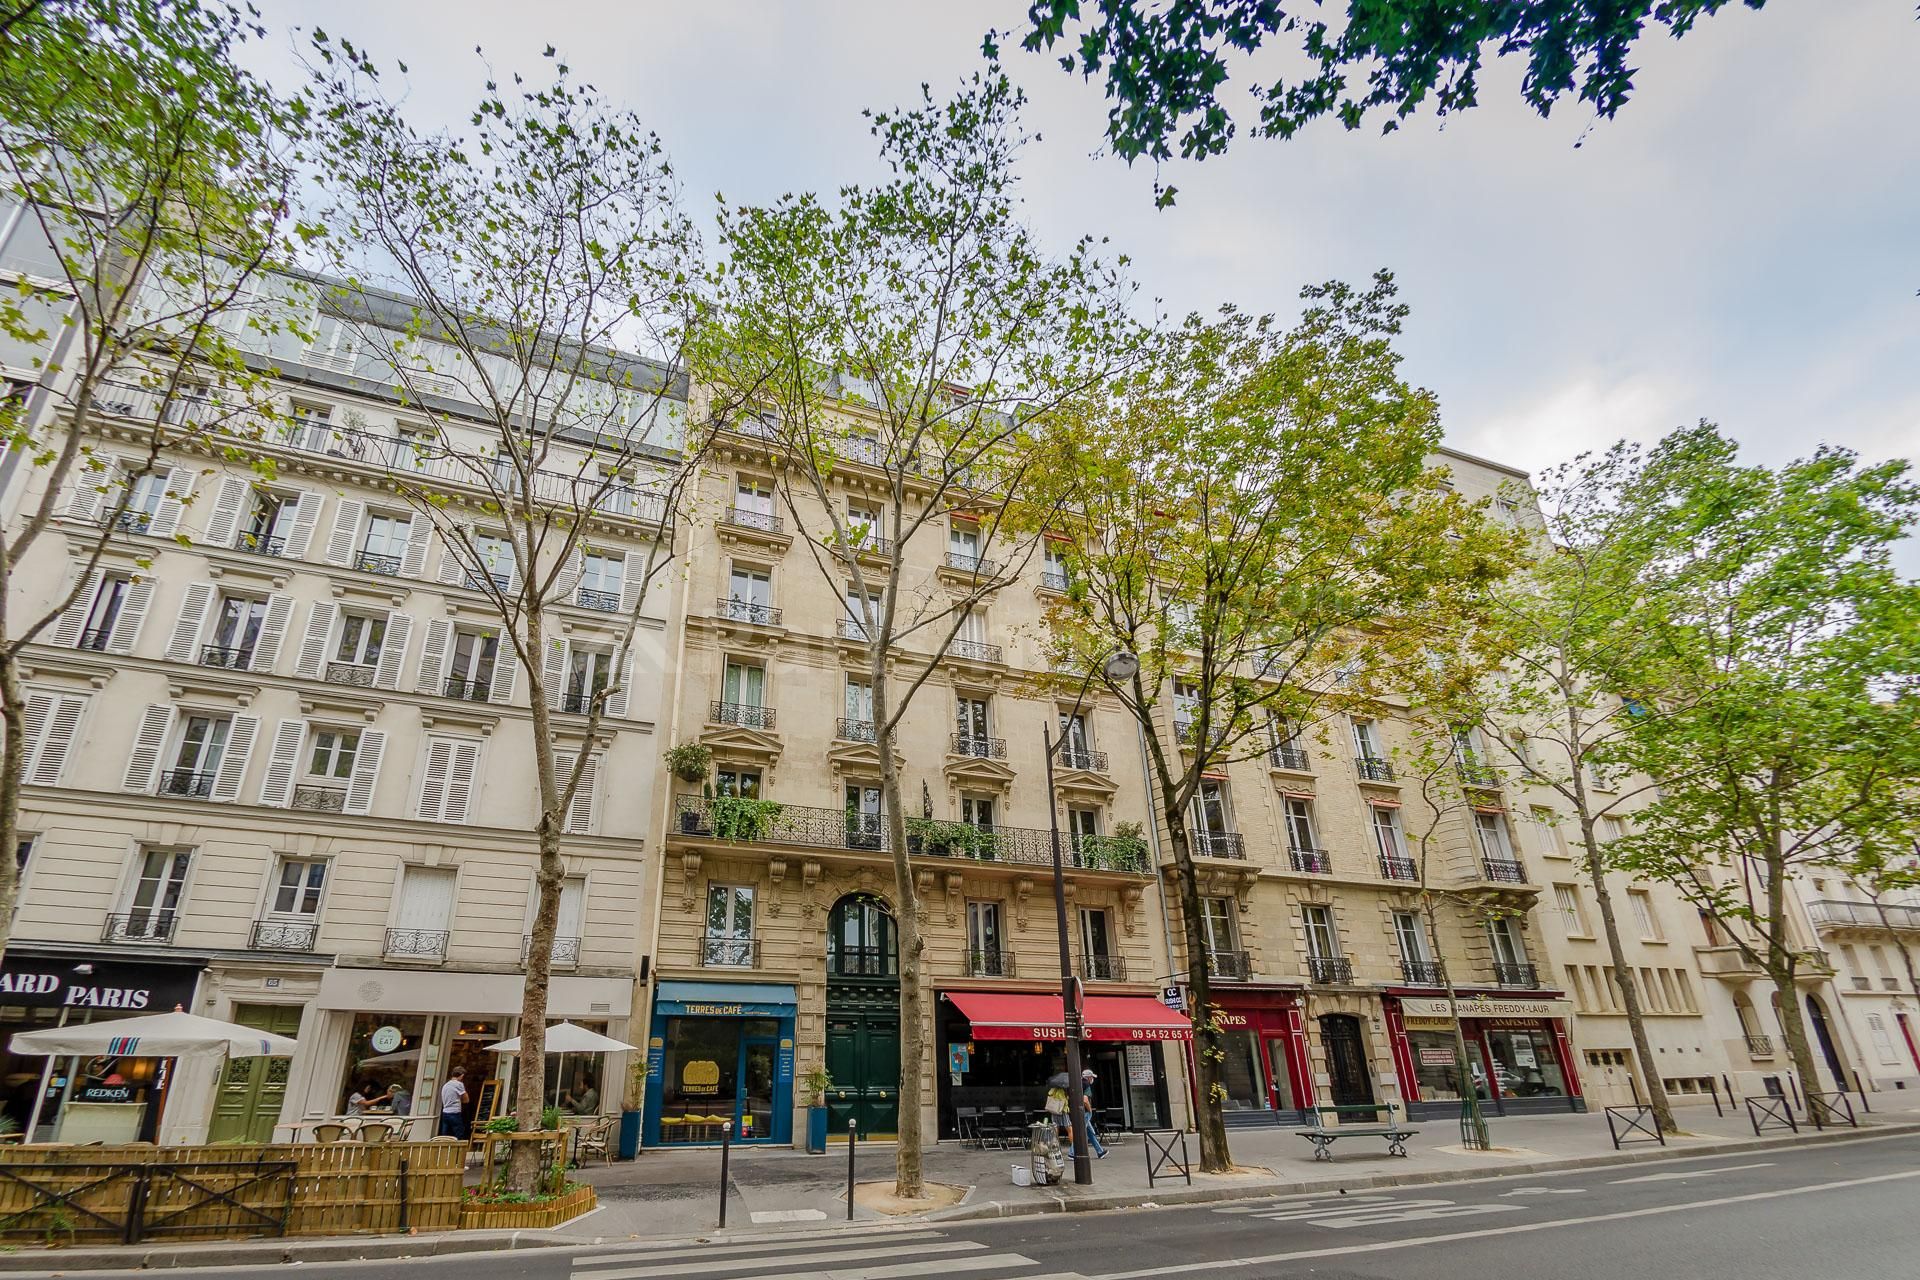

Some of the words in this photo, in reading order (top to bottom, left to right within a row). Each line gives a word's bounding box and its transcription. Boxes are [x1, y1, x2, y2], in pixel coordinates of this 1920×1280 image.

[267, 979, 278, 987] 65
[64, 985, 150, 1009] PARIS
[686, 1004, 715, 1014] TERRES
[1430, 1003, 1447, 1013] LES
[1456, 1004, 1491, 1013] ANAPES
[1211, 1015, 1247, 1025] ANAPES
[1033, 1028, 1066, 1038] SUSH
[1132, 1029, 1143, 1039] 09
[1145, 1030, 1157, 1039] 54
[1158, 1030, 1170, 1039] 52
[1171, 1030, 1182, 1039] 65
